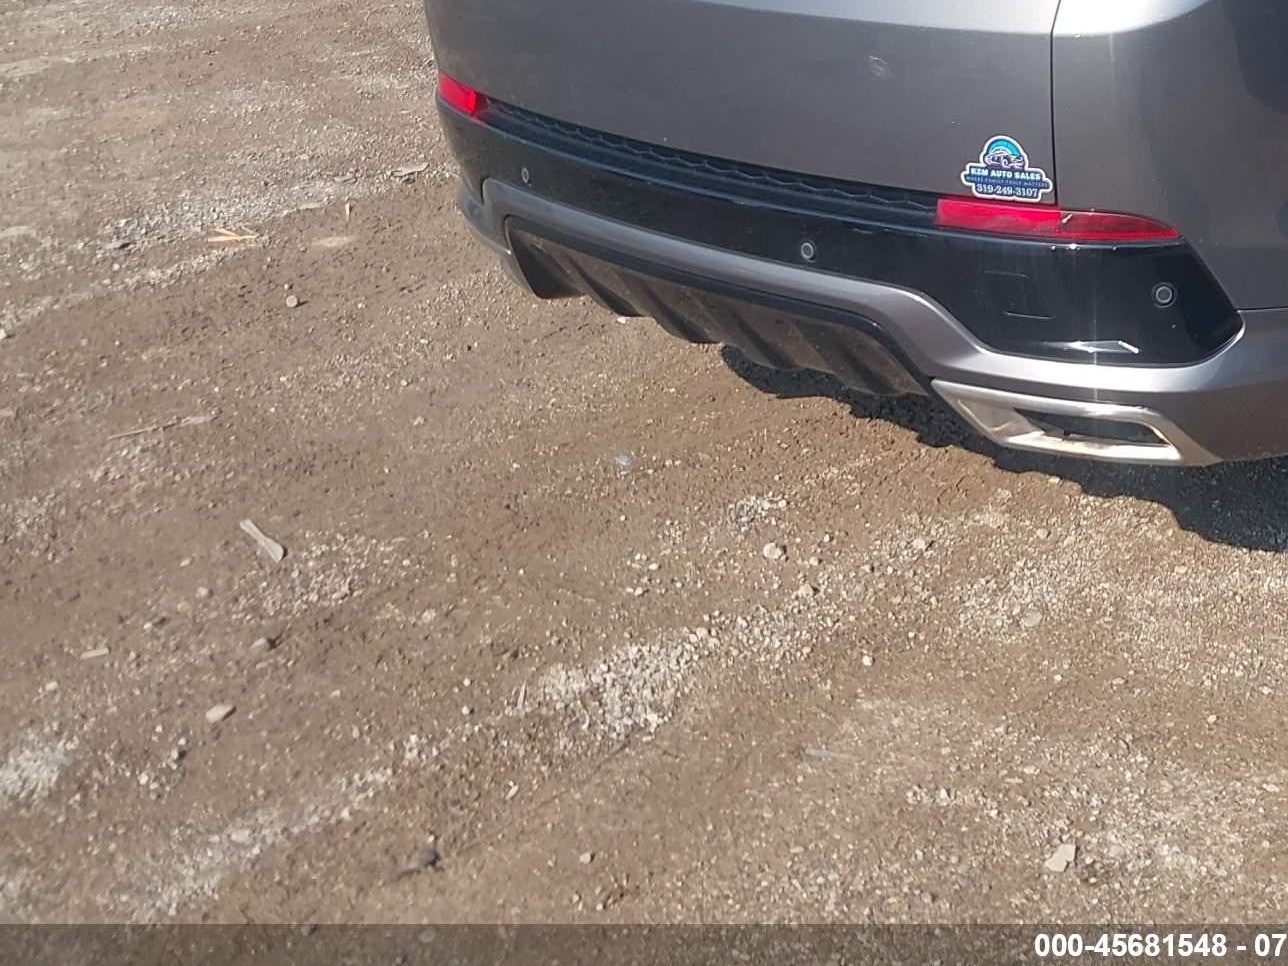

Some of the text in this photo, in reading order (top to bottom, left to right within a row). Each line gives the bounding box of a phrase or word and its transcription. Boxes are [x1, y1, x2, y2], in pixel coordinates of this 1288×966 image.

[990, 170, 1012, 178] AUTO
[1014, 172, 1041, 180] SALES
[977, 184, 1038, 197] 319-249-3107
